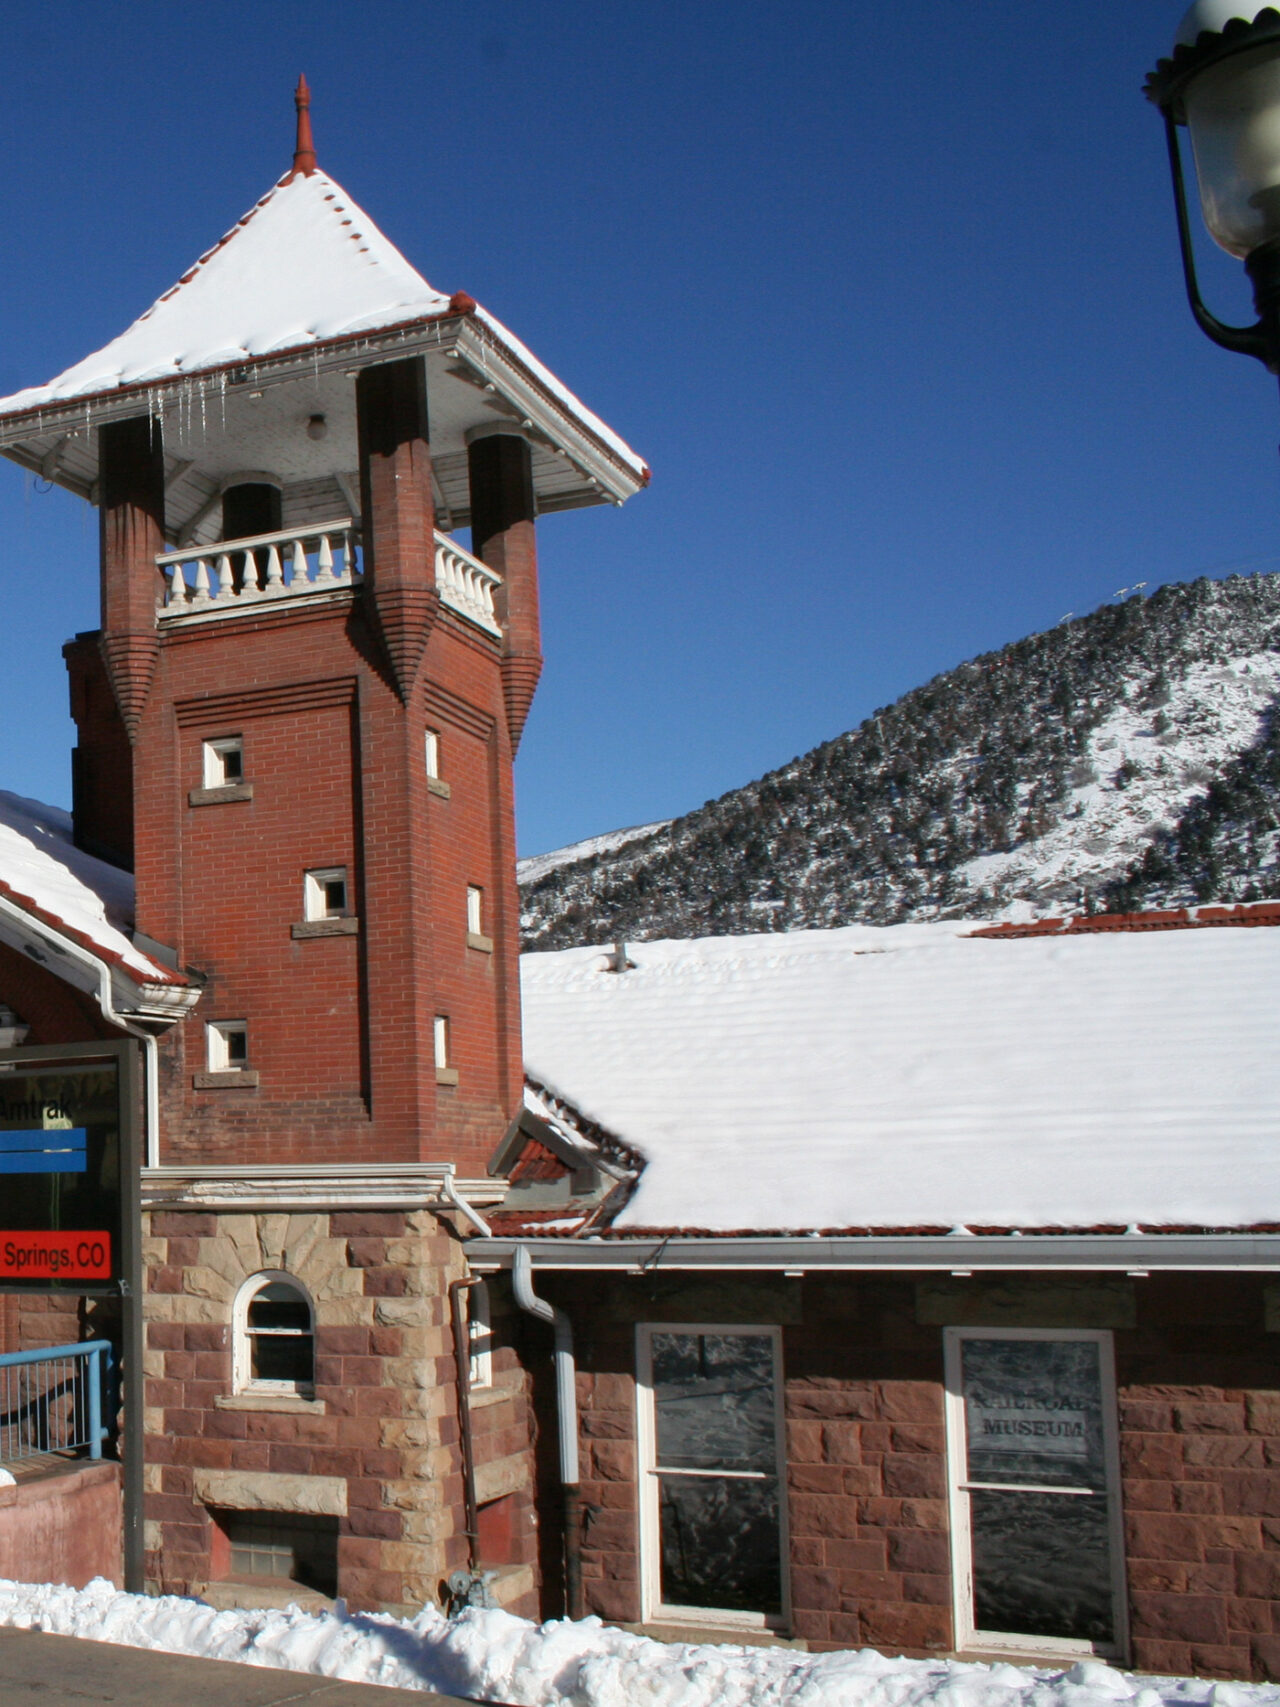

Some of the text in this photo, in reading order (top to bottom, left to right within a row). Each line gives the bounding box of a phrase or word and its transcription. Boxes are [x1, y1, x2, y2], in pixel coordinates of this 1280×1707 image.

[4, 1242, 75, 1272] Springs,
[76, 1243, 105, 1268] CO
[983, 1419, 1083, 1437] MUSEUM
